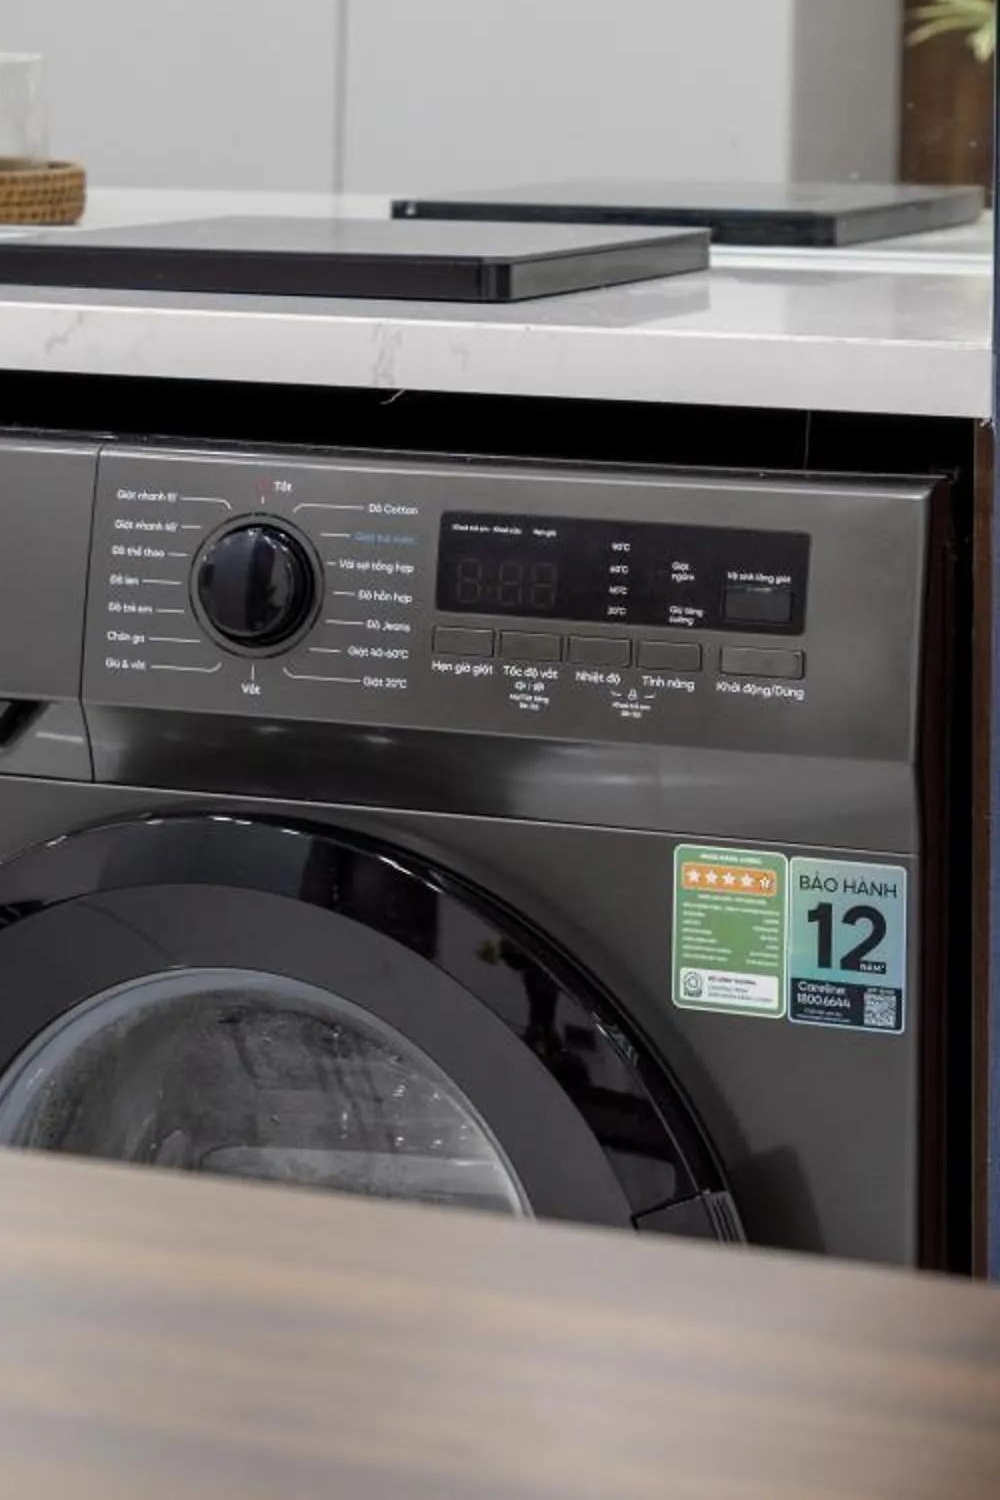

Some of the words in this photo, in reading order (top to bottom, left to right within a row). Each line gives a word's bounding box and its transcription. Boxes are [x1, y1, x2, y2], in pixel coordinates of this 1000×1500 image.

[383, 504, 419, 515] Cotton
[381, 621, 411, 633] Jeans
[843, 877, 898, 899] HÀNH
[807, 902, 887, 971] 12
